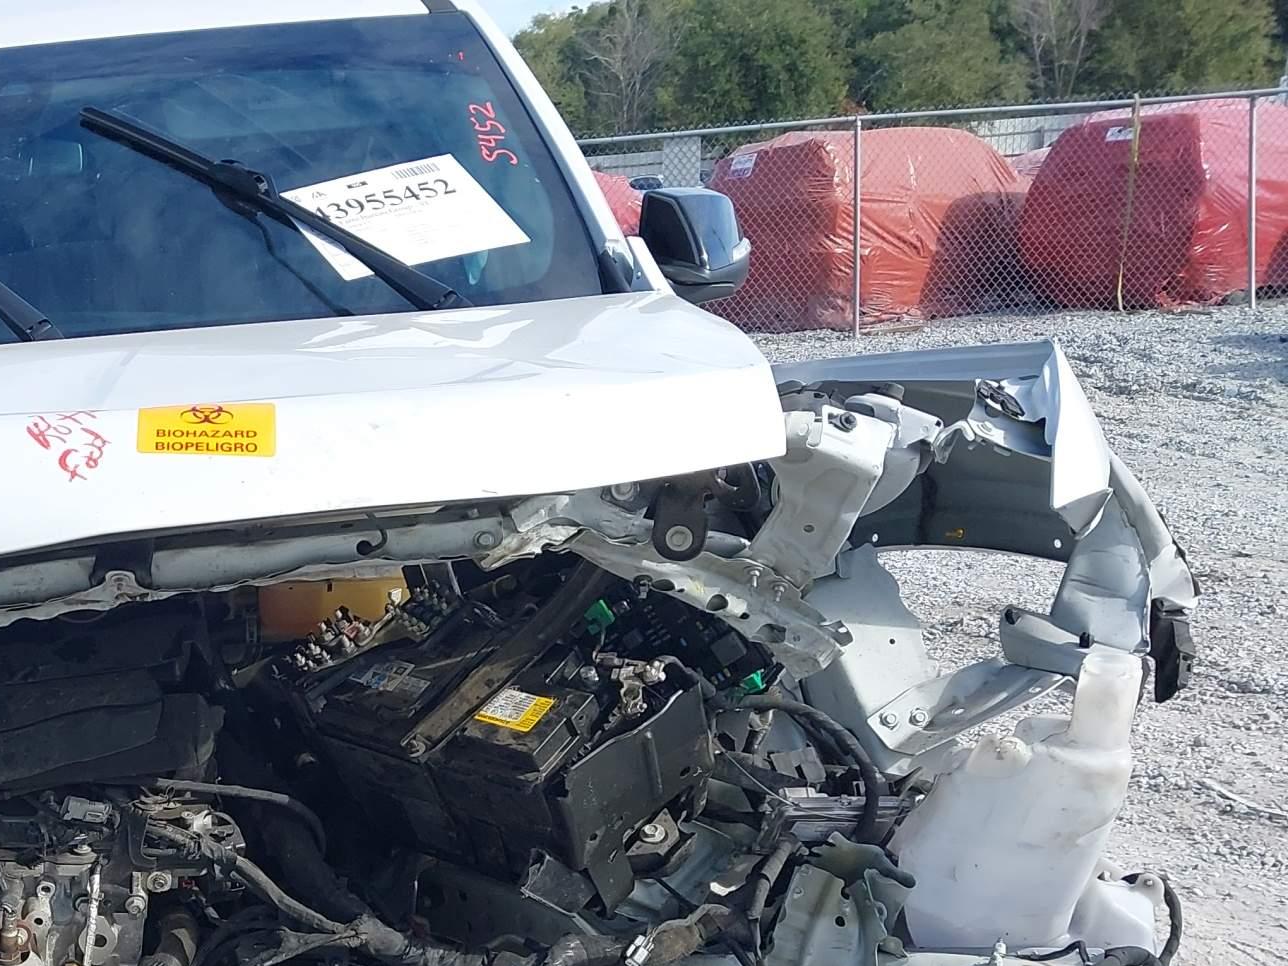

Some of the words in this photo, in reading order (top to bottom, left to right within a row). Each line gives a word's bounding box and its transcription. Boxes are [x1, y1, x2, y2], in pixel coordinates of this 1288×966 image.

[469, 102, 519, 165] 5452
[155, 429, 257, 439] BIOHAZARD
[154, 441, 258, 453] BIOPELIGRO
